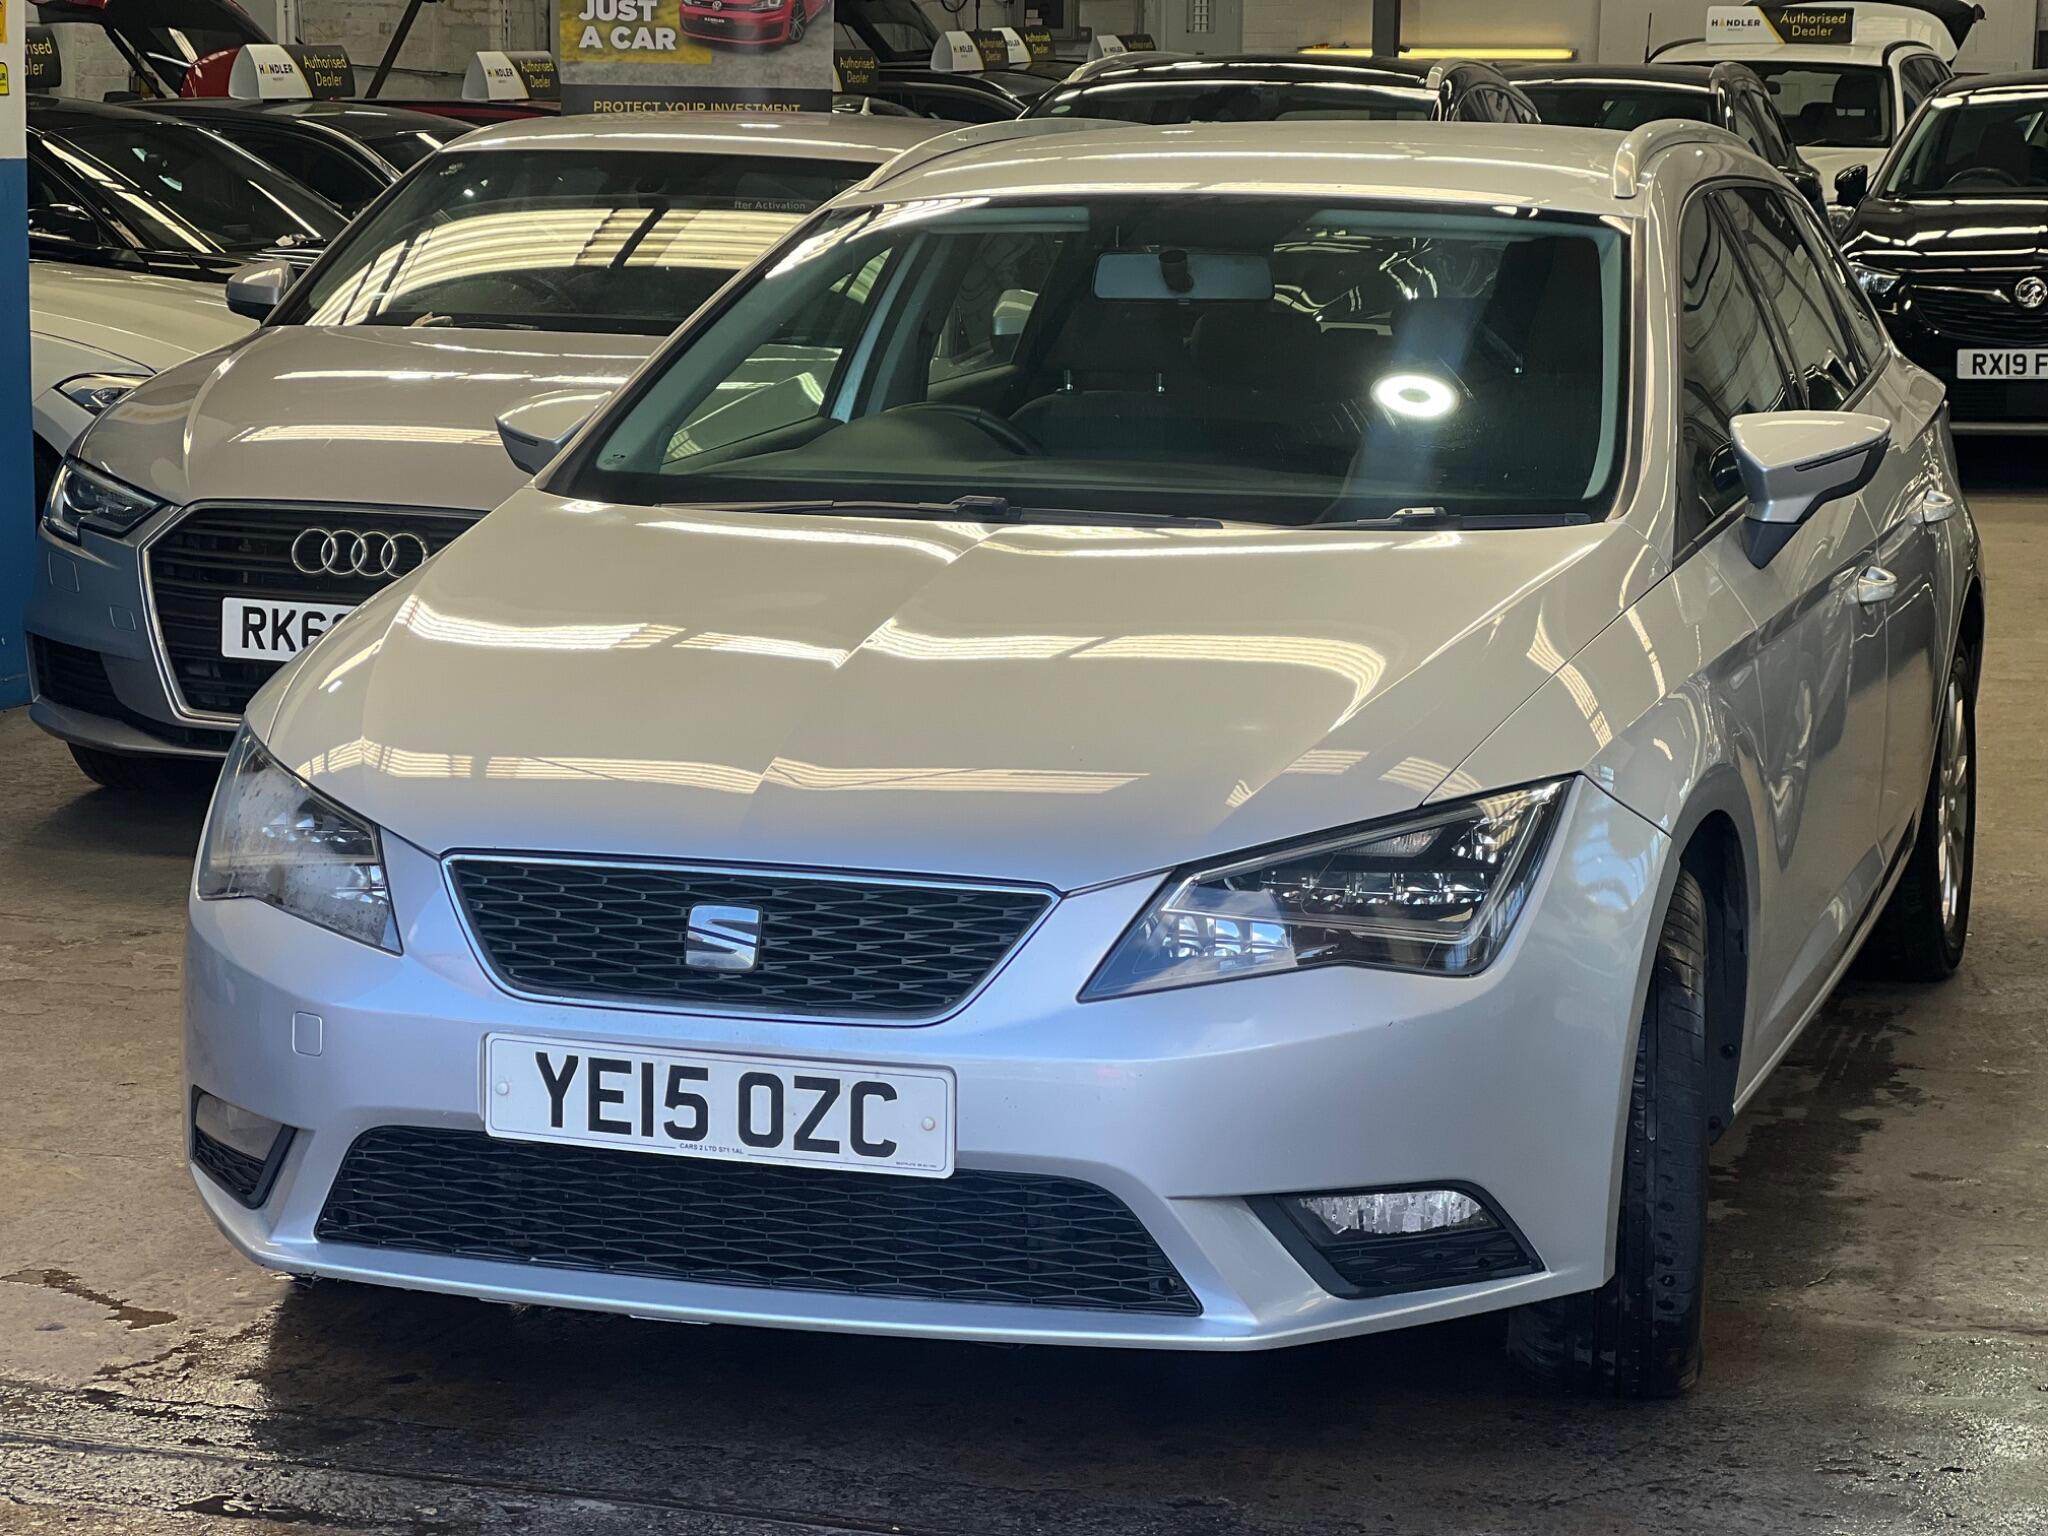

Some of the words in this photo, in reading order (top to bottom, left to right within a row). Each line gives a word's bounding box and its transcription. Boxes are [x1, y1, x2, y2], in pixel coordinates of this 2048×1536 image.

[579, 0, 656, 22] JUST
[1780, 10, 1847, 24] Authorised
[579, 26, 603, 49] A
[610, 26, 677, 50] CAR
[1792, 25, 1833, 37] Dealer
[303, 54, 348, 69] Authorised
[315, 70, 342, 87] Dealer
[593, 100, 660, 112] PROTECT
[755, 201, 806, 210] Activation
[1972, 353, 2027, 375] RX19
[535, 1052, 709, 1142] YE15
[738, 1071, 898, 1159] OZC
[679, 1142, 698, 1150] CARS
